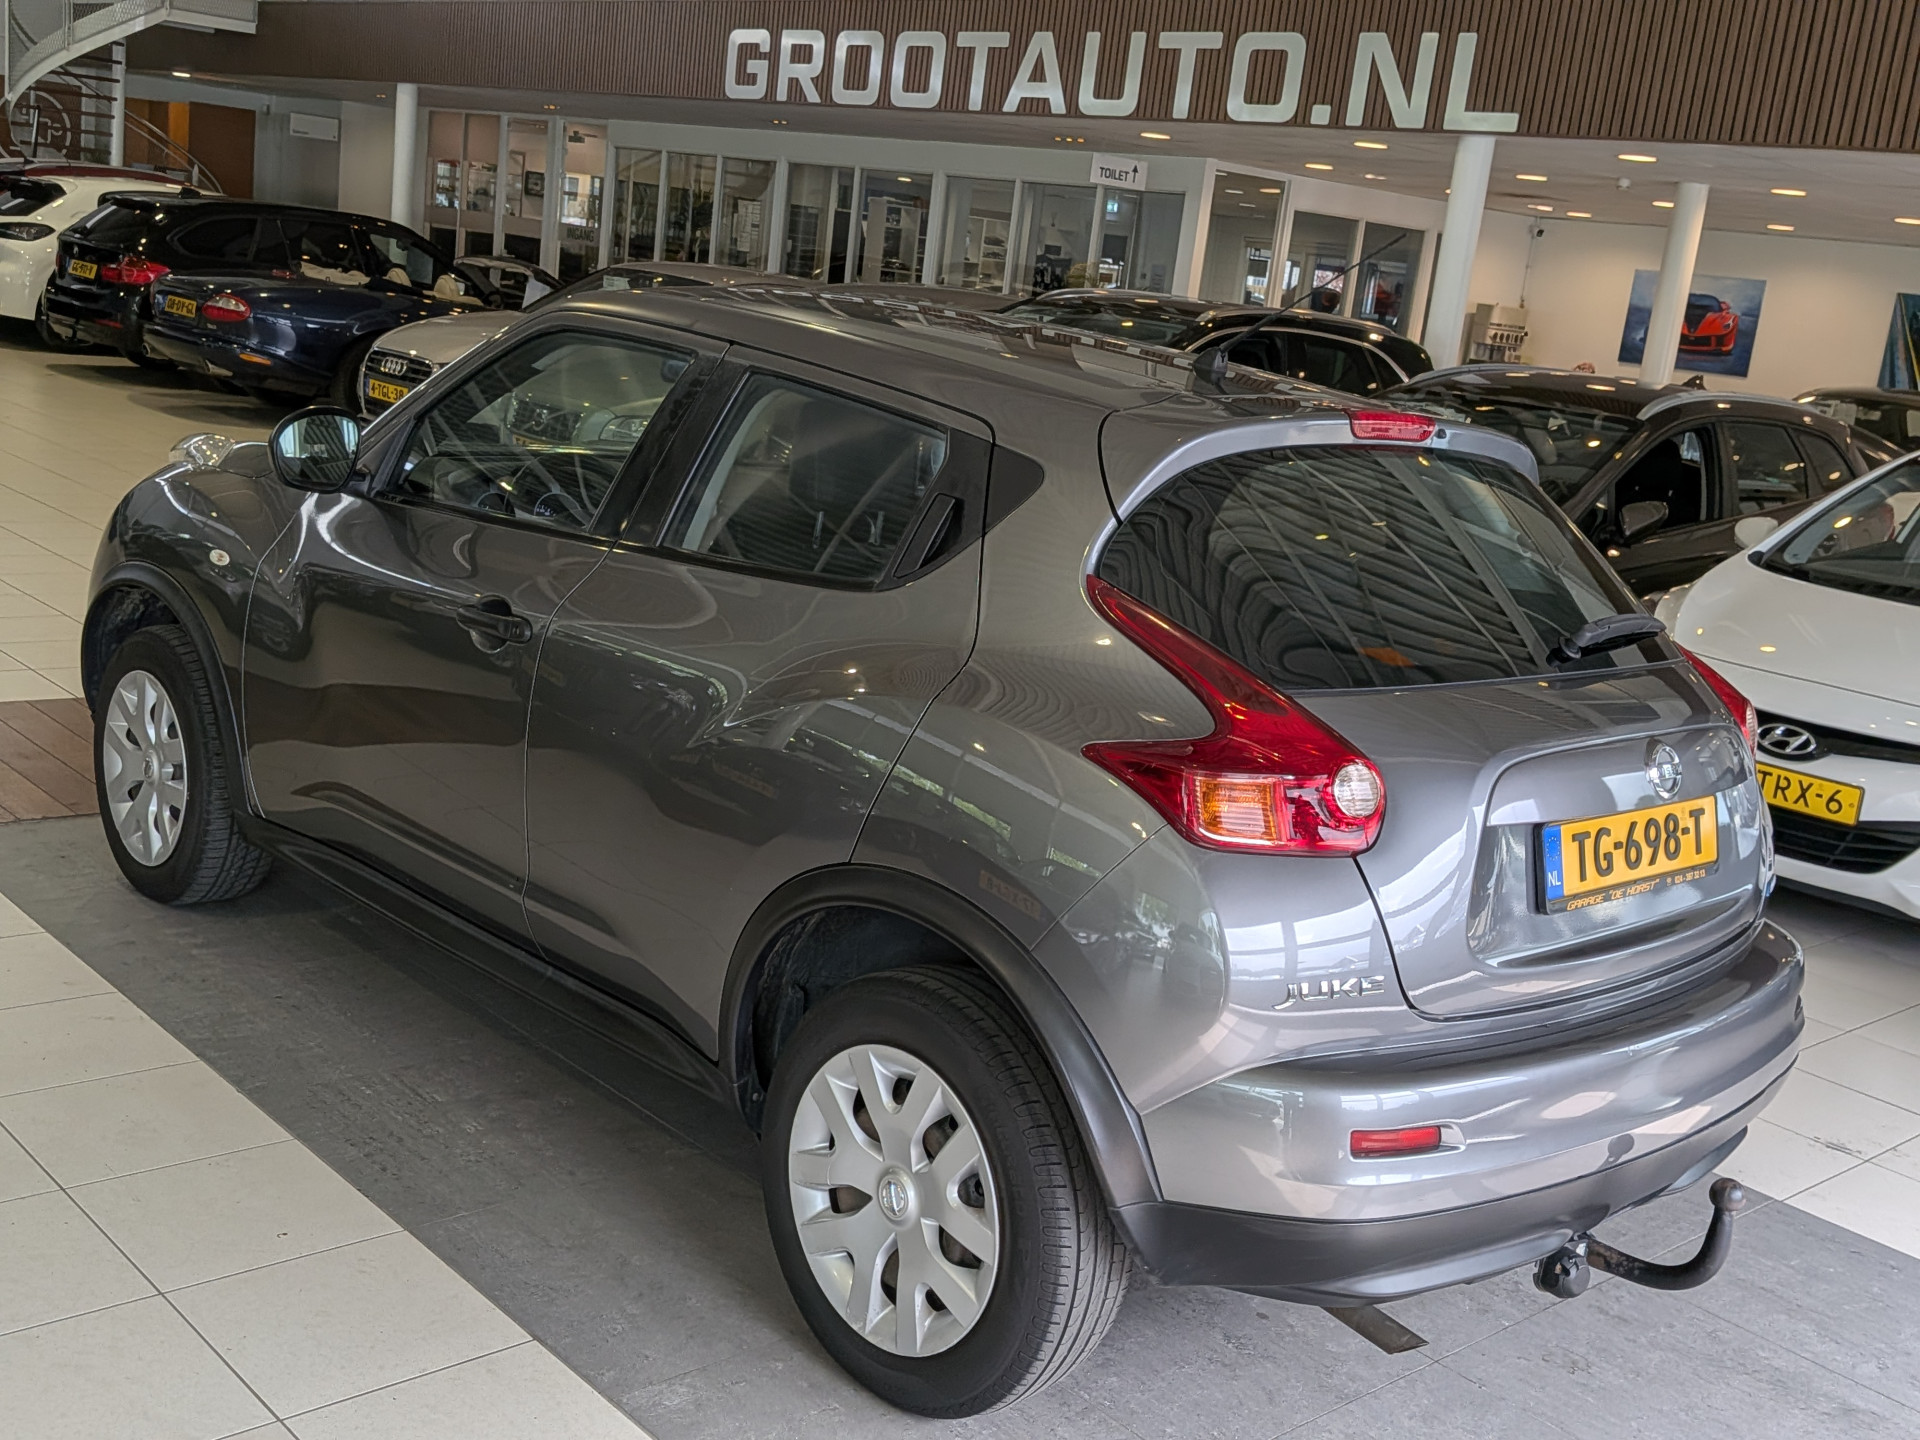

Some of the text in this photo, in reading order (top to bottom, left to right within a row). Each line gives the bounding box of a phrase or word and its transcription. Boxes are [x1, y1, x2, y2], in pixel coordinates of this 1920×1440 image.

[725, 28, 1520, 133] GROOTAUTO.NL
[1099, 166, 1130, 182] TOILET
[566, 226, 595, 242] INGANG
[1571, 807, 1706, 883] TG-698-T
[1547, 870, 1562, 887] NL
[1566, 893, 1606, 911] GARAGE
[1271, 975, 1385, 1010] JUKE
